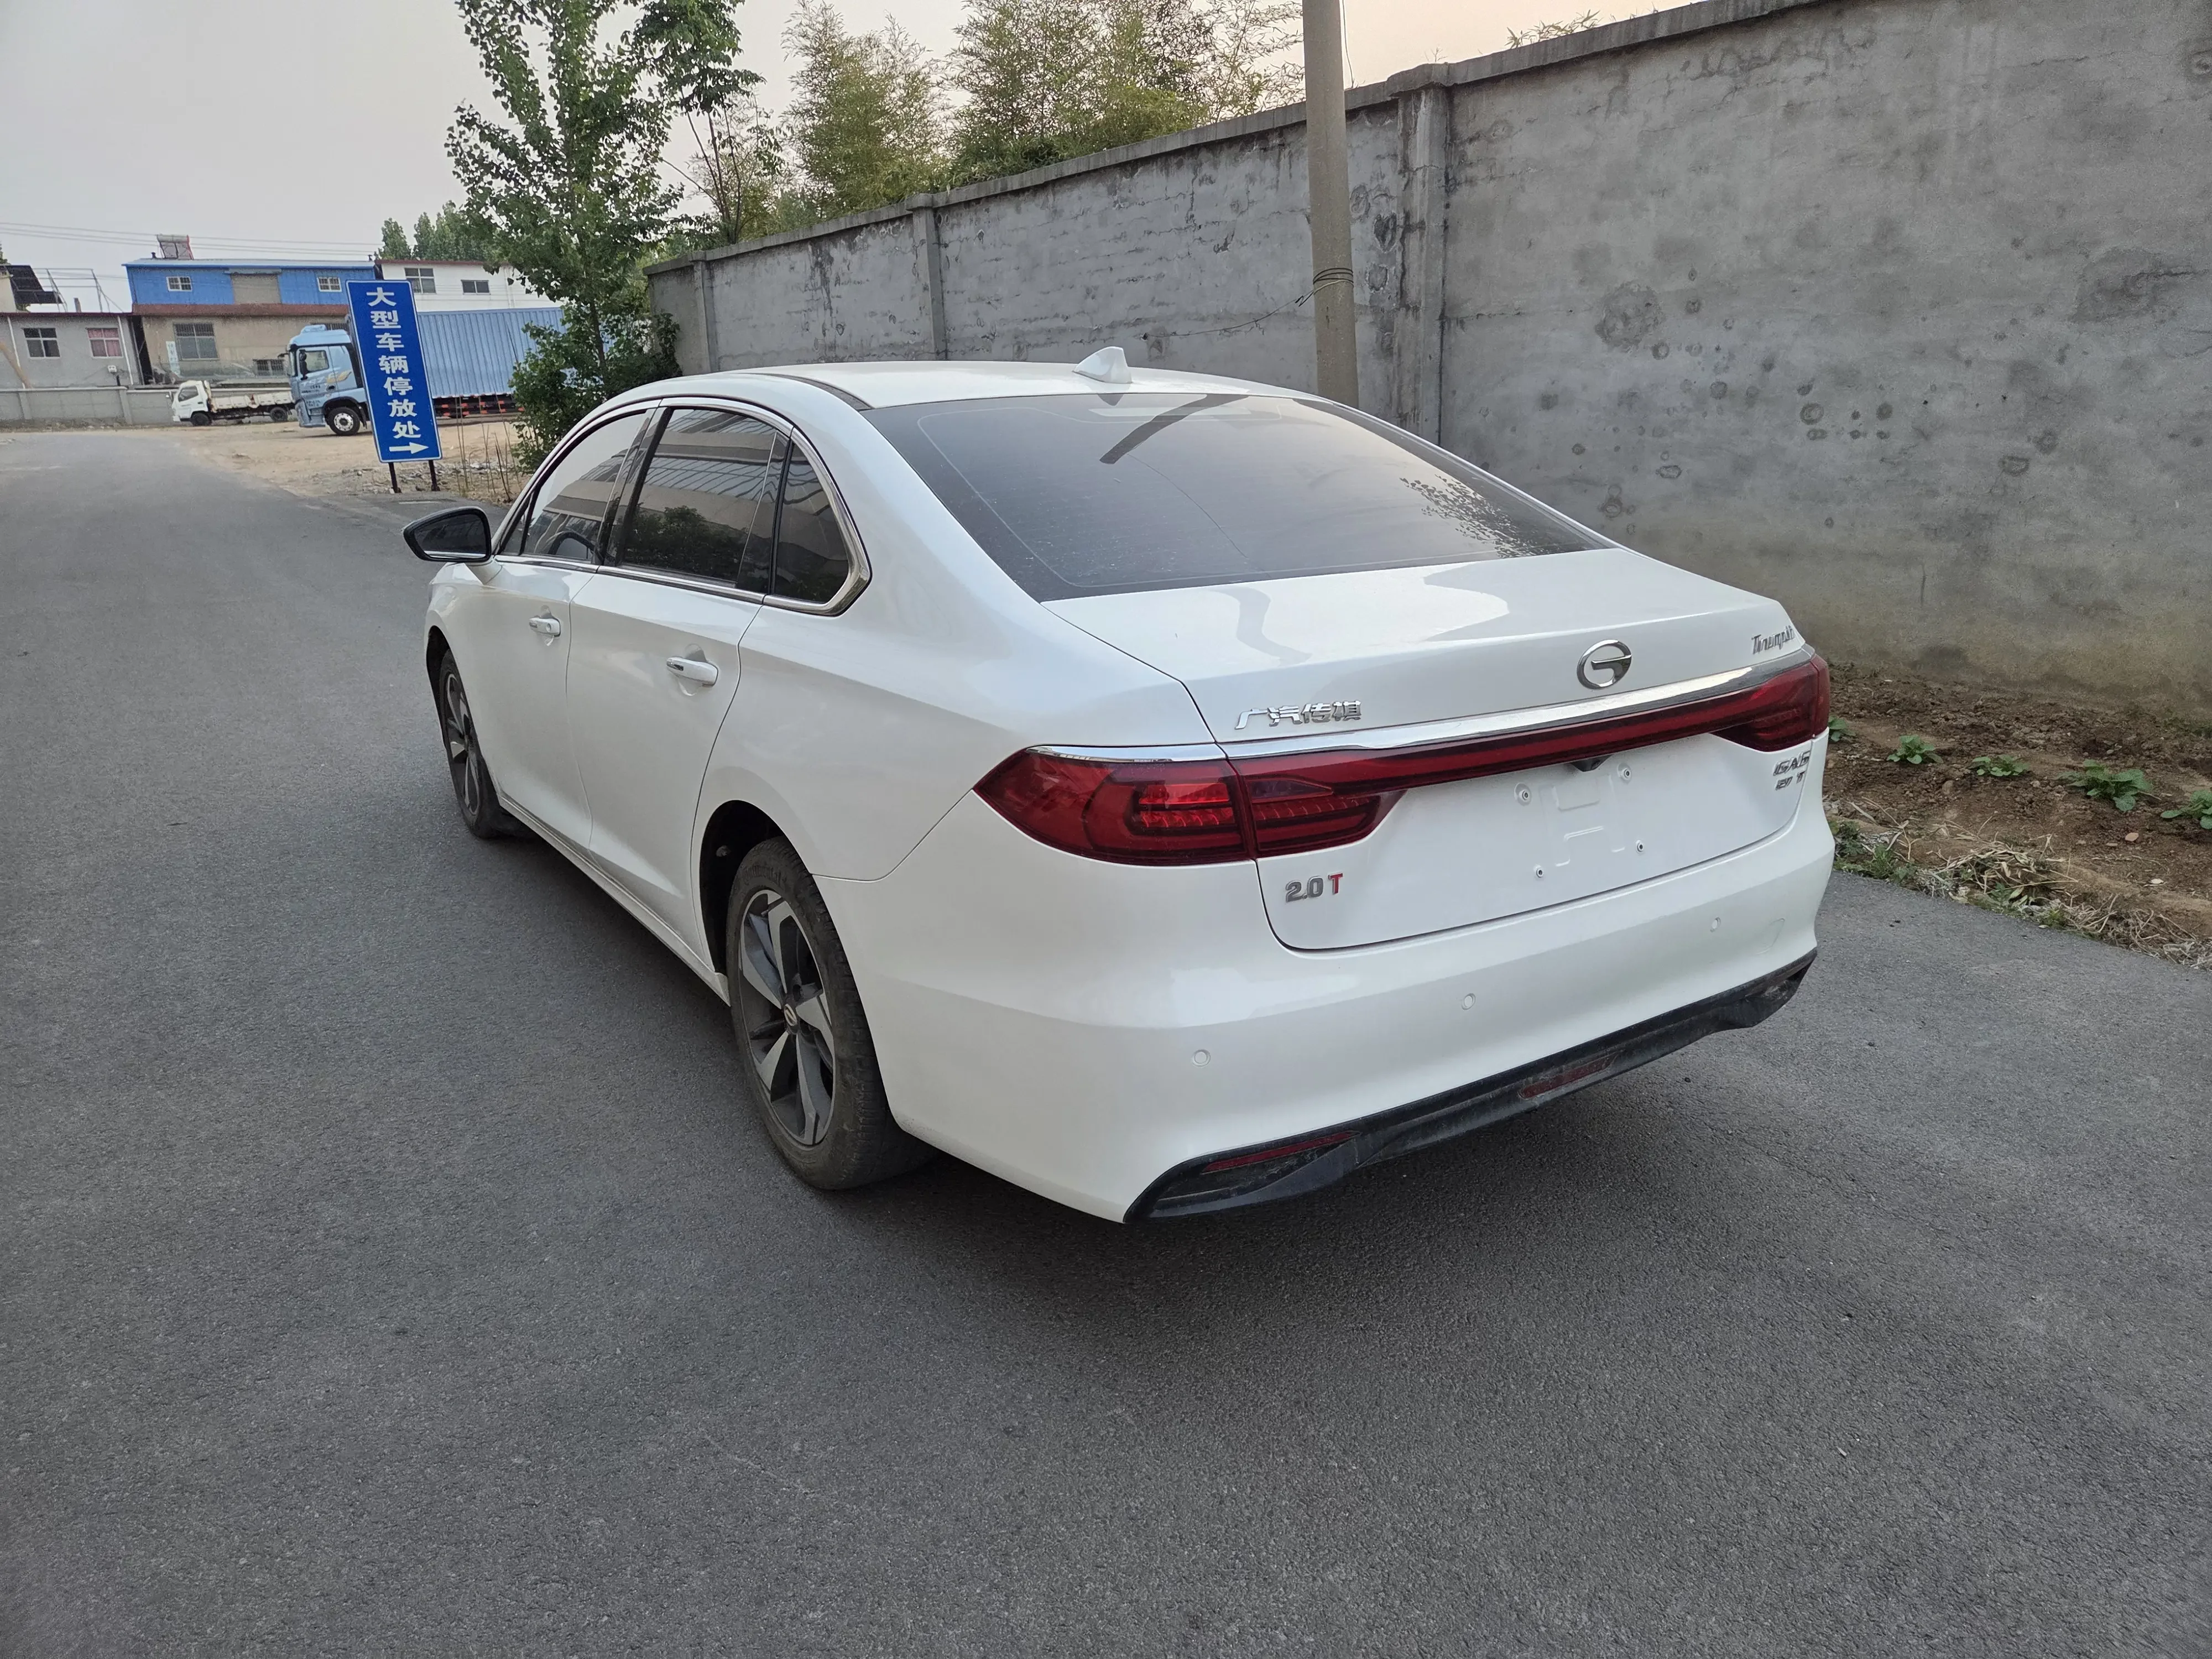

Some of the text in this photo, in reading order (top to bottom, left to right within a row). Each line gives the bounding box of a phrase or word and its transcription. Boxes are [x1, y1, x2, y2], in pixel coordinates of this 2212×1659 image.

[367, 287, 421, 439] 大型车辆停放处
[1234, 700, 1361, 730] 广汽传祺
